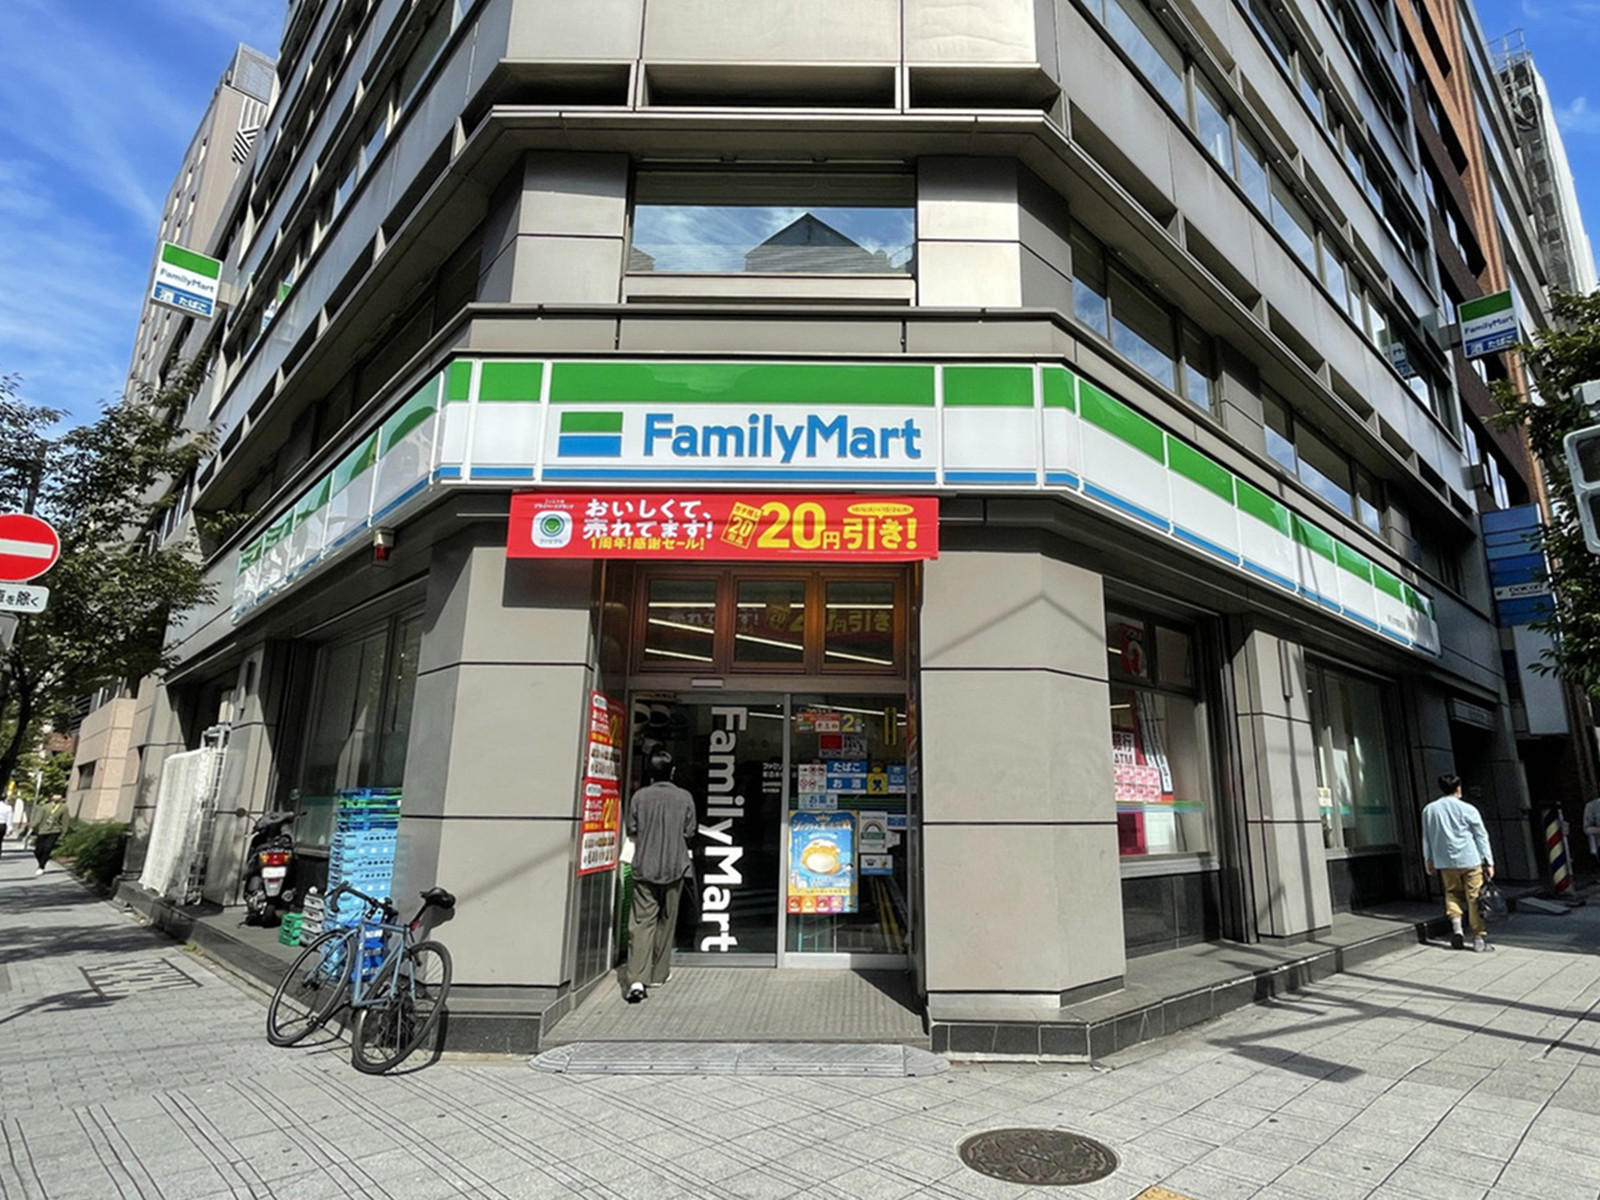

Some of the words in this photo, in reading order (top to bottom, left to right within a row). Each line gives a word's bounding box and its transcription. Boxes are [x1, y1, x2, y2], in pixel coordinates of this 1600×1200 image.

[160, 268, 214, 293] FamilyMart
[1464, 315, 1514, 335] FamilyMart
[643, 413, 922, 464] FamilyMart
[585, 498, 712, 518] おいしくて、
[583, 519, 714, 539] 売れてます!
[728, 516, 754, 538] 20
[590, 537, 705, 551] 1周年!感謝セール!
[833, 762, 860, 773] たばこ
[1114, 752, 1133, 764] ATM
[698, 706, 748, 952] FamilyMart
